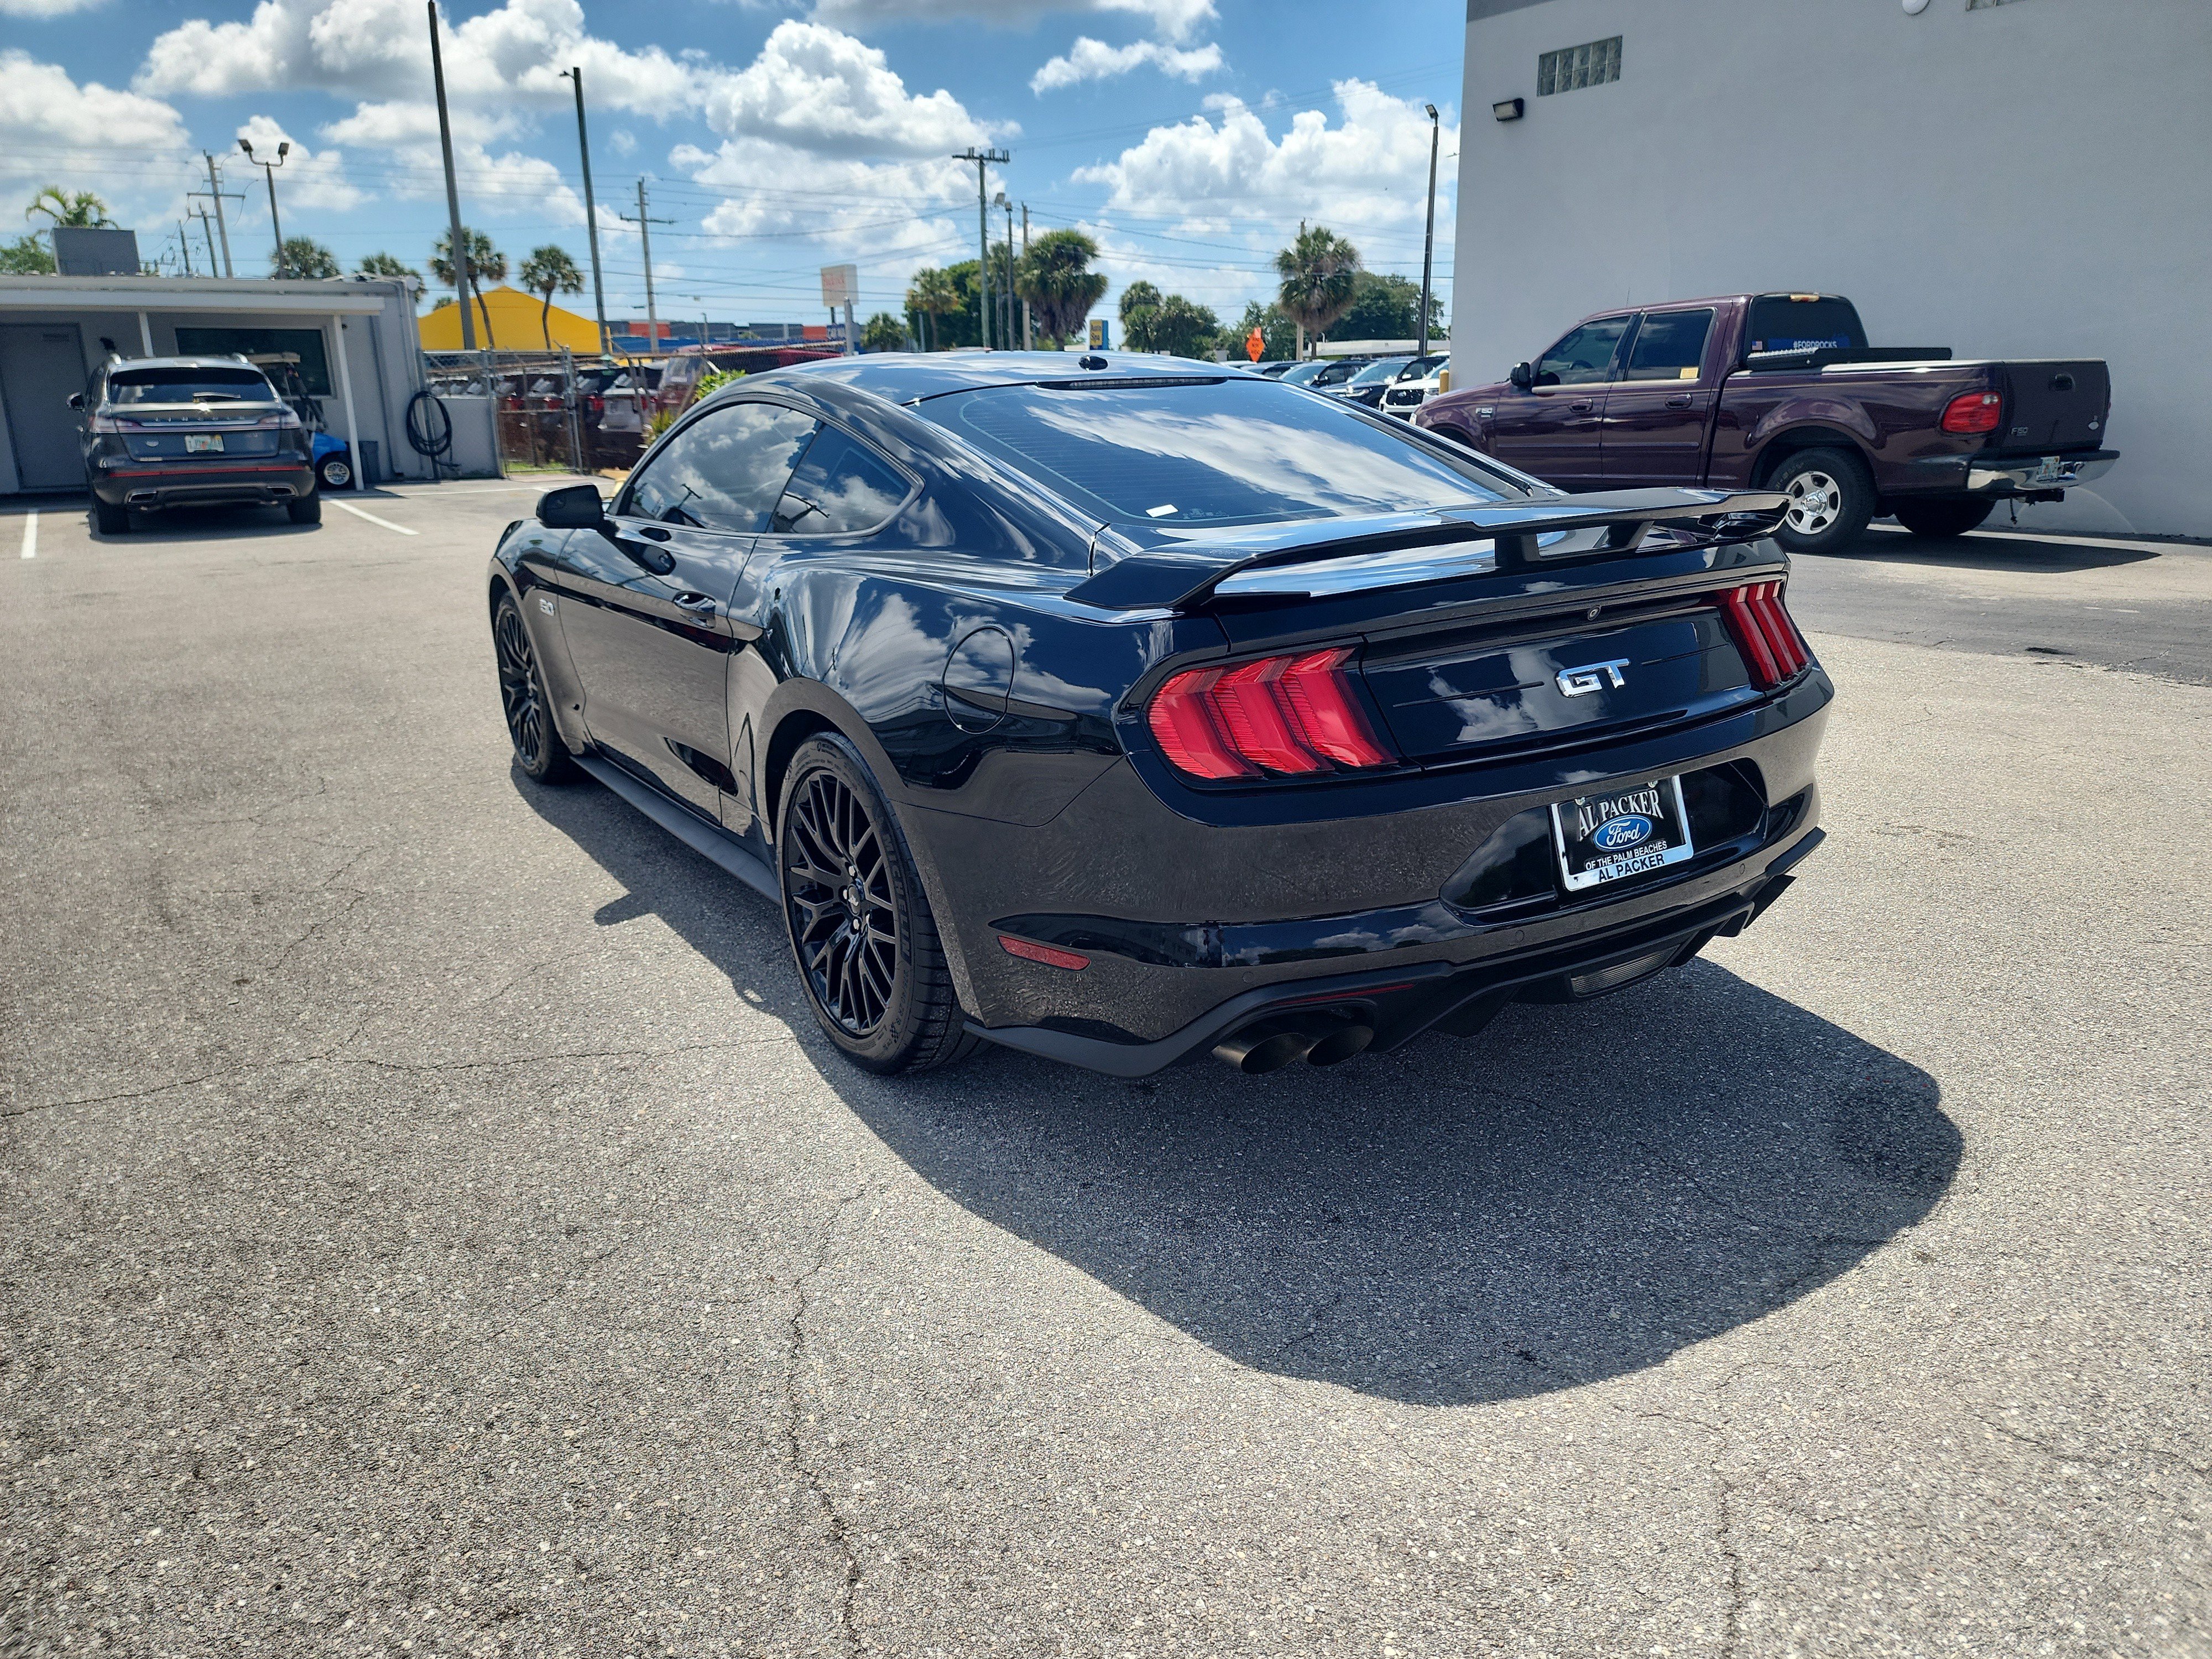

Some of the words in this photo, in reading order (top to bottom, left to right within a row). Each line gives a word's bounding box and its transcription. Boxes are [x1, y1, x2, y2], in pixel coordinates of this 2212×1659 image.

[1555, 658, 1630, 698] GT
[1578, 805, 1599, 842] AL
[1599, 789, 1664, 822] PACKER
[1606, 821, 1641, 846] Ford
[1585, 859, 1596, 870] OF
[1597, 855, 1613, 868] THE
[1613, 849, 1633, 864] PALM
[1633, 840, 1668, 858] BEACHES
[1599, 867, 1614, 883] AL
[1615, 853, 1665, 877] PACKER
[882, 833, 911, 958] MICHELIN
